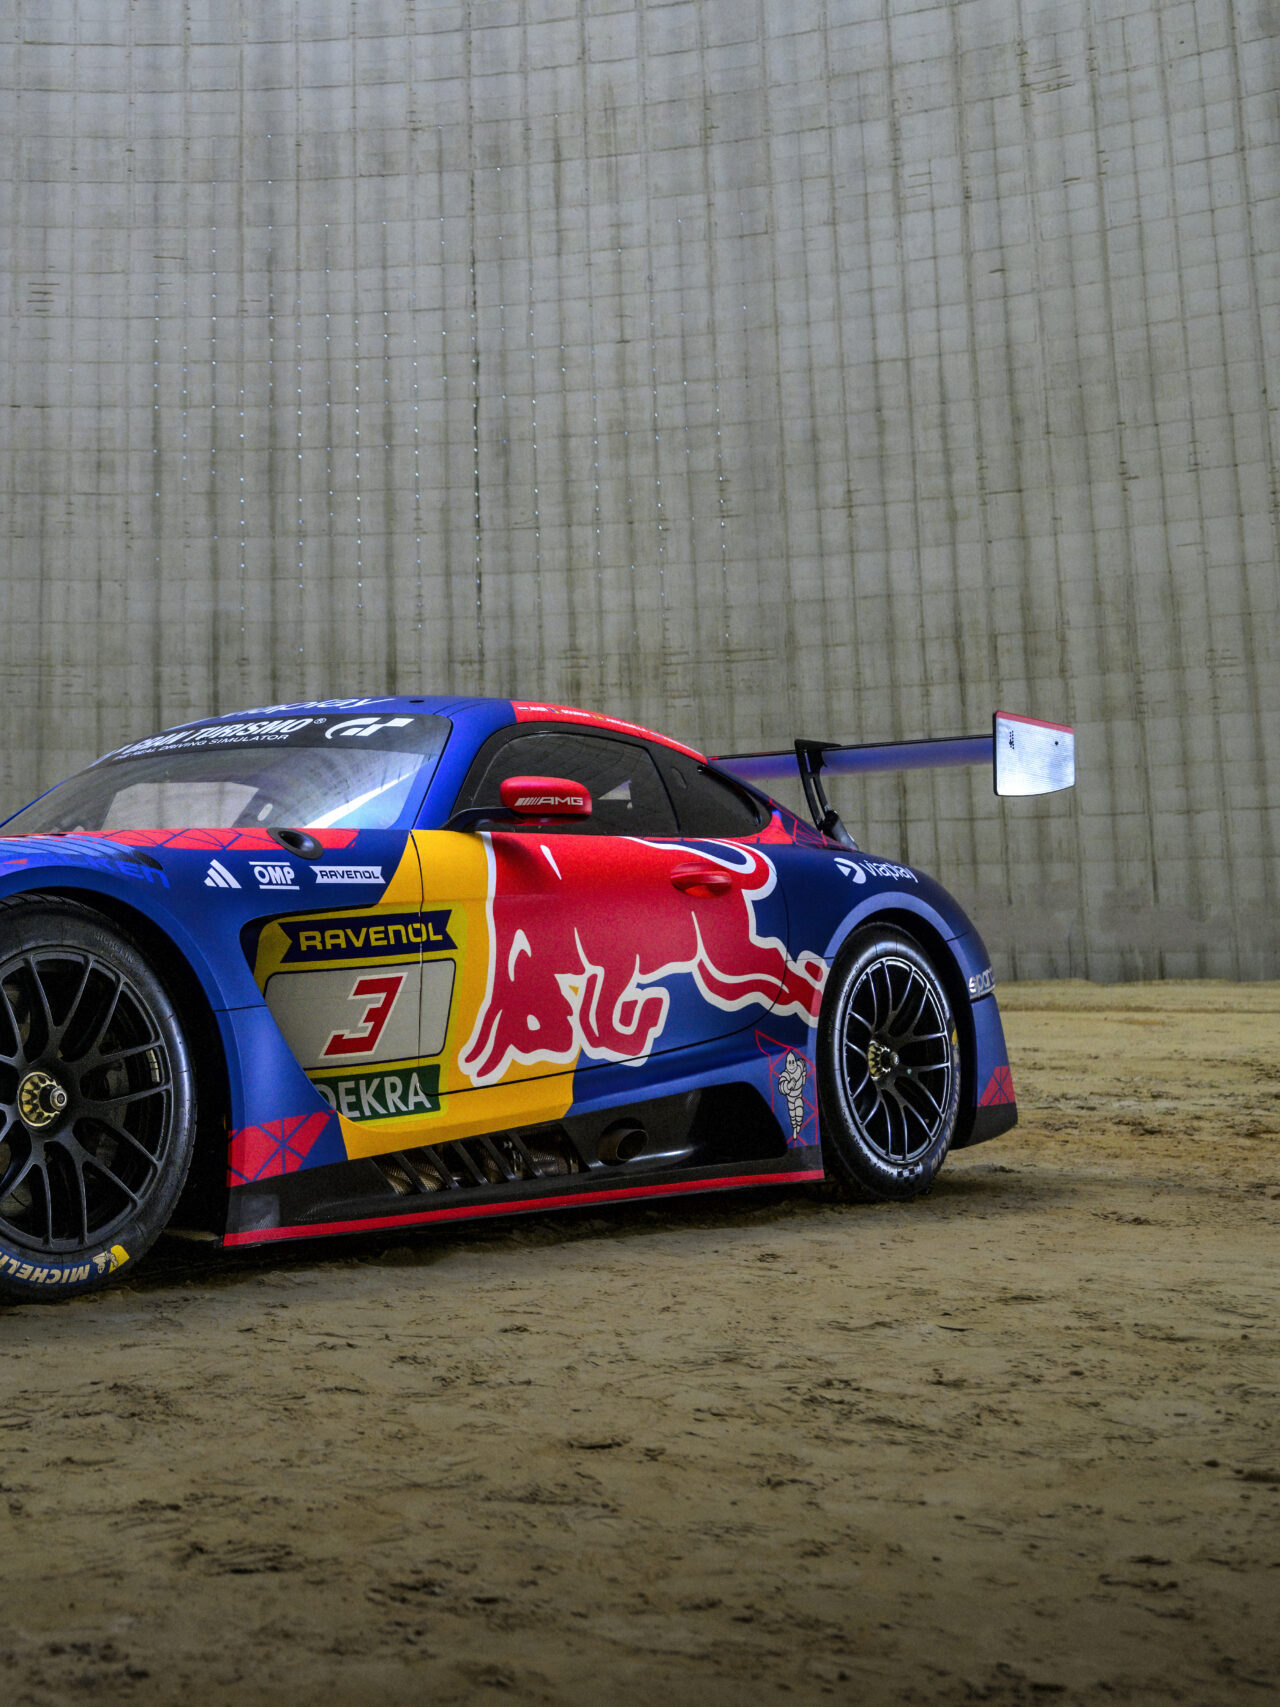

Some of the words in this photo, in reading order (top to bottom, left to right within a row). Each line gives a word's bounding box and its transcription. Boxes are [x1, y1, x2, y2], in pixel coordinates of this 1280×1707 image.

[208, 734, 289, 745] SIMULATOR
[537, 797, 583, 806] AMG
[253, 866, 295, 884] OMP
[319, 870, 380, 879] RAVENOL
[859, 860, 918, 883] viaplay
[299, 922, 442, 951] RAVENOL
[969, 967, 995, 994] spar
[320, 972, 408, 1059] 3
